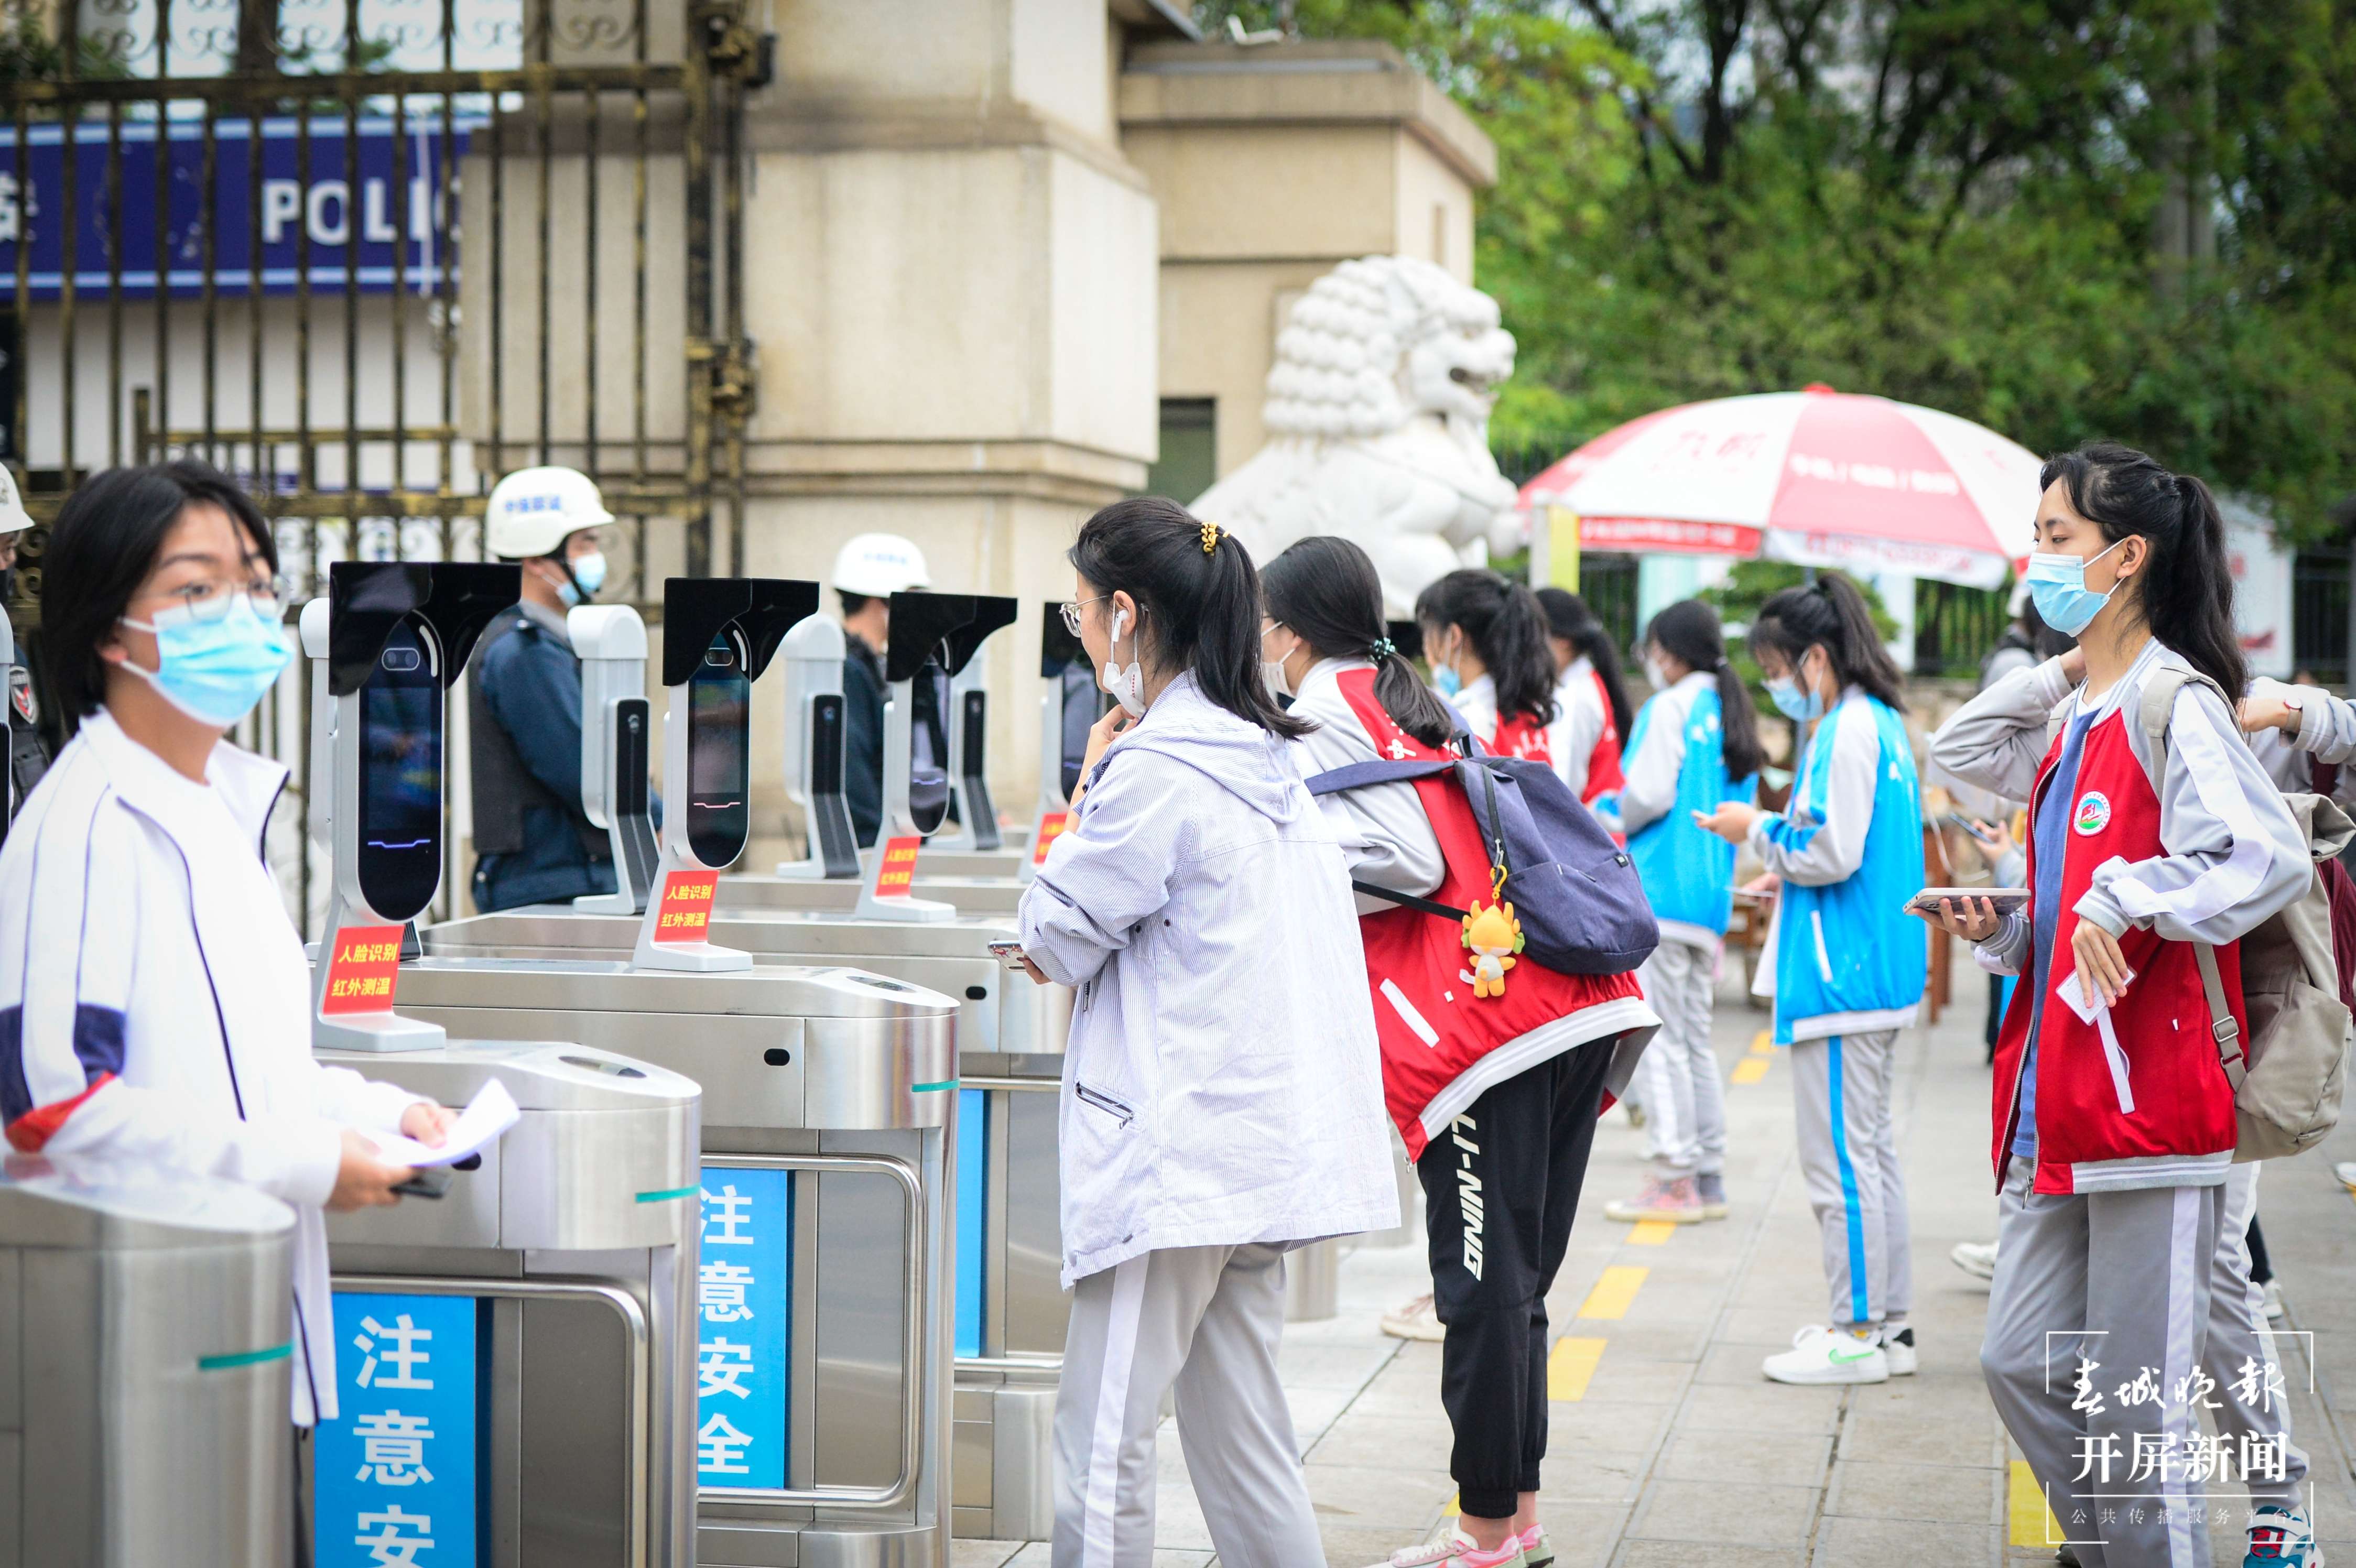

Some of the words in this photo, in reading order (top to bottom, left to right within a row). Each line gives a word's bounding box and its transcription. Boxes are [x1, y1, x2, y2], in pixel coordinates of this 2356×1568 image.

[666, 884, 713, 900] 人脸识别
[660, 912, 707, 928] 红外测温
[338, 943, 398, 964] 人脸识别
[331, 976, 391, 997] 红外测温
[1451, 1113, 1484, 1281] LI-NING
